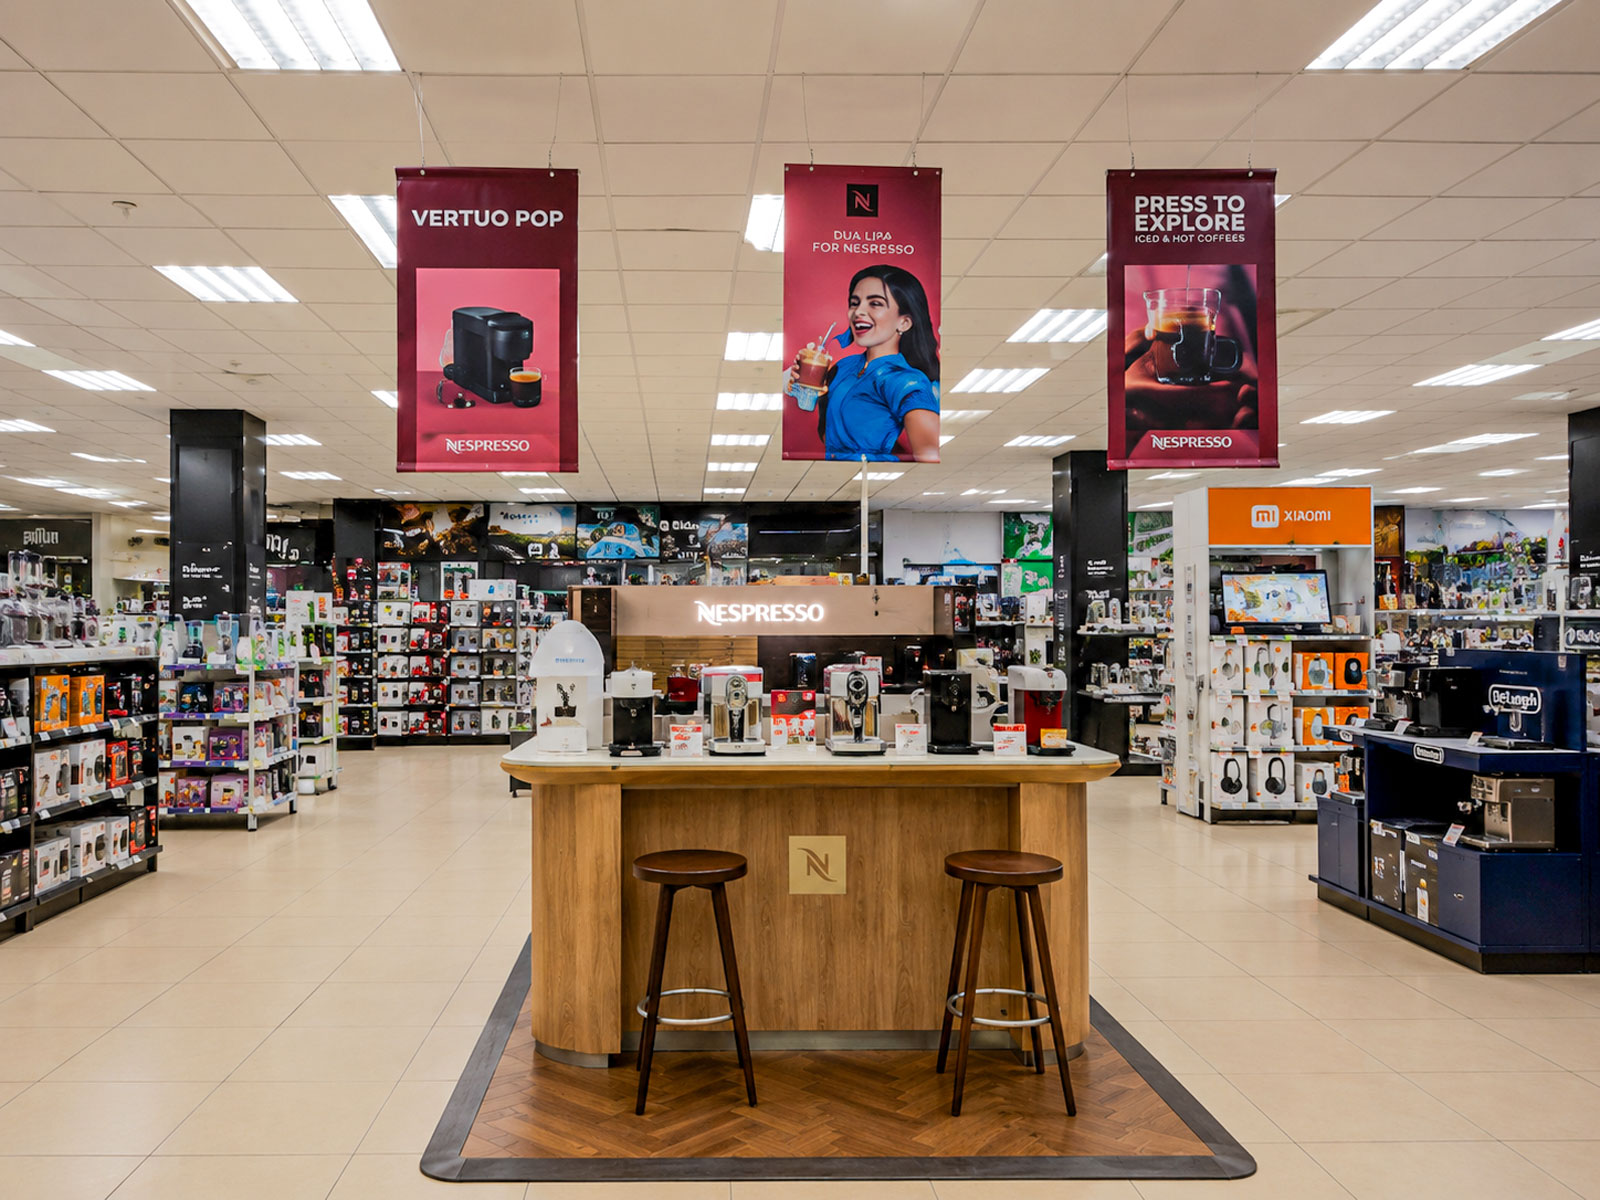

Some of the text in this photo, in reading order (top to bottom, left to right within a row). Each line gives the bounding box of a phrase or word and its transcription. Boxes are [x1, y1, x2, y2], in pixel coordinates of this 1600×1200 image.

[1135, 195, 1245, 213] PRESS TO
[411, 209, 564, 228] VERTUO POP
[1135, 214, 1245, 232] EXPLORE
[833, 230, 893, 241] DUA LIPA
[1135, 233, 1246, 243] ICED & HOT COFFEES
[812, 242, 840, 253] FOR
[445, 438, 530, 454] NESPRESSO
[1150, 434, 1233, 450] NESPRESSO
[1283, 510, 1332, 522] XIAOMI
[694, 600, 825, 626] NESPRESSO
